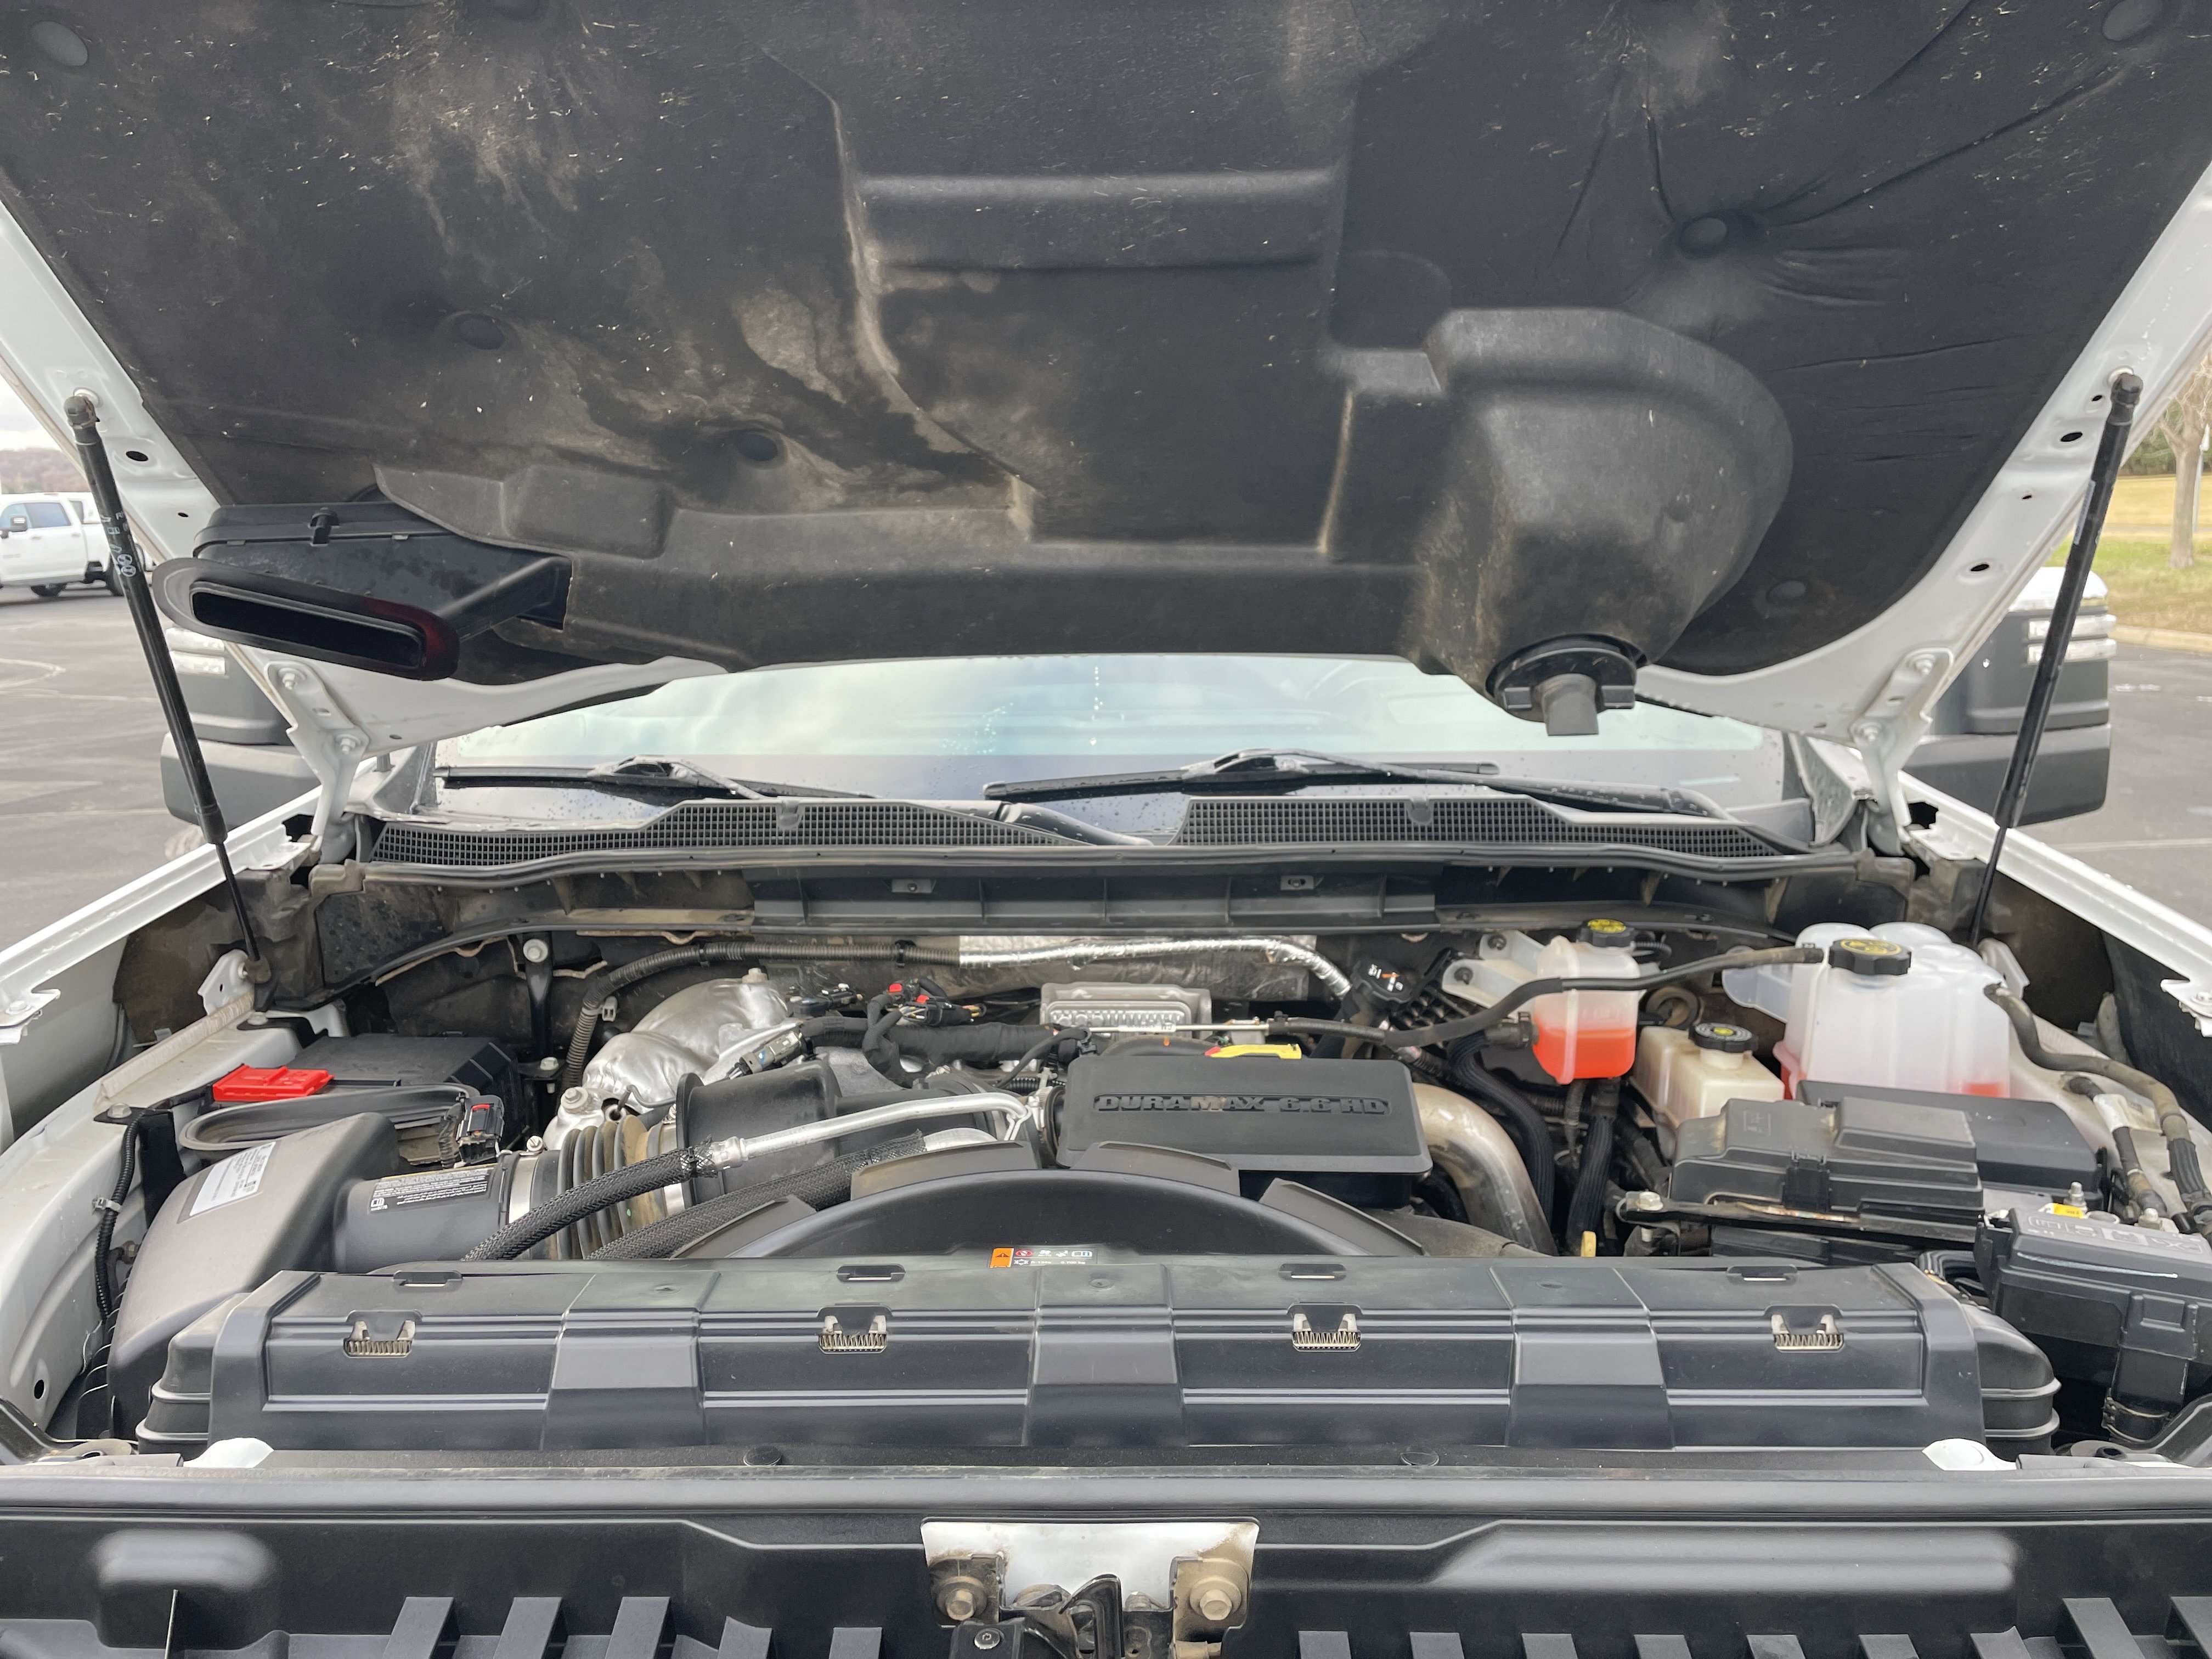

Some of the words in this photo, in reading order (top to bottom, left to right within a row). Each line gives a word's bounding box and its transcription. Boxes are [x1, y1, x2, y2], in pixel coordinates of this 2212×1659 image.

[1098, 1096, 1265, 1111] DURAMAX
[1279, 1097, 1331, 1113] 6.6
[1340, 1098, 1386, 1115] HD
